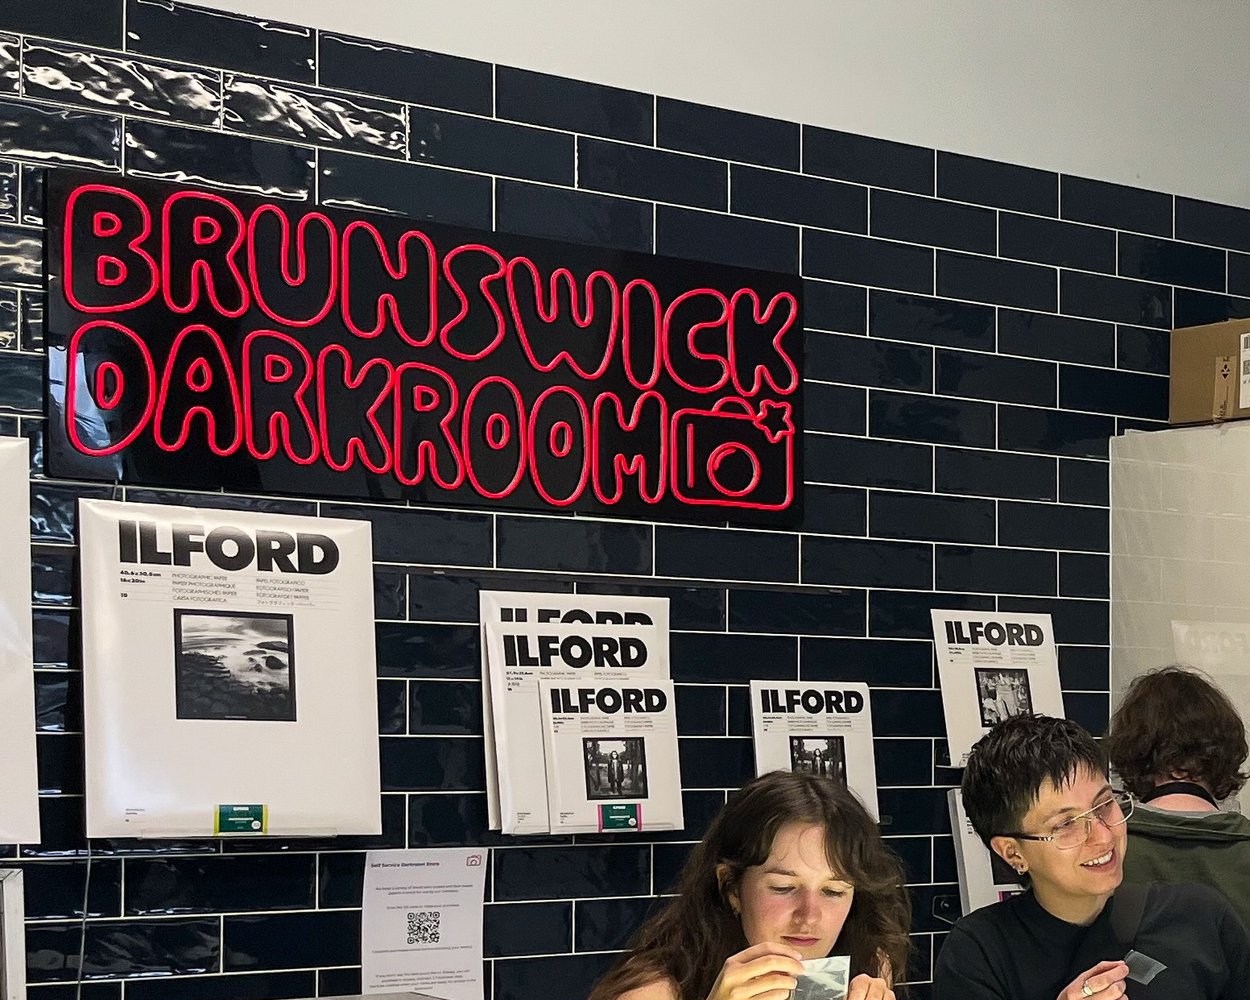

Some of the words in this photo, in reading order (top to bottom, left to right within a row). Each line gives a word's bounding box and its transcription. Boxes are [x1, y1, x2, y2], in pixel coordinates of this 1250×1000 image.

[64, 184, 798, 396] BRUNSWICK
[67, 321, 668, 506] DARKROOM
[119, 519, 340, 575] ILFORD
[944, 620, 1044, 647] ILFORD
[503, 634, 649, 669] ILFORD
[550, 687, 668, 714] ILFORD
[760, 689, 864, 715] ILFORD
